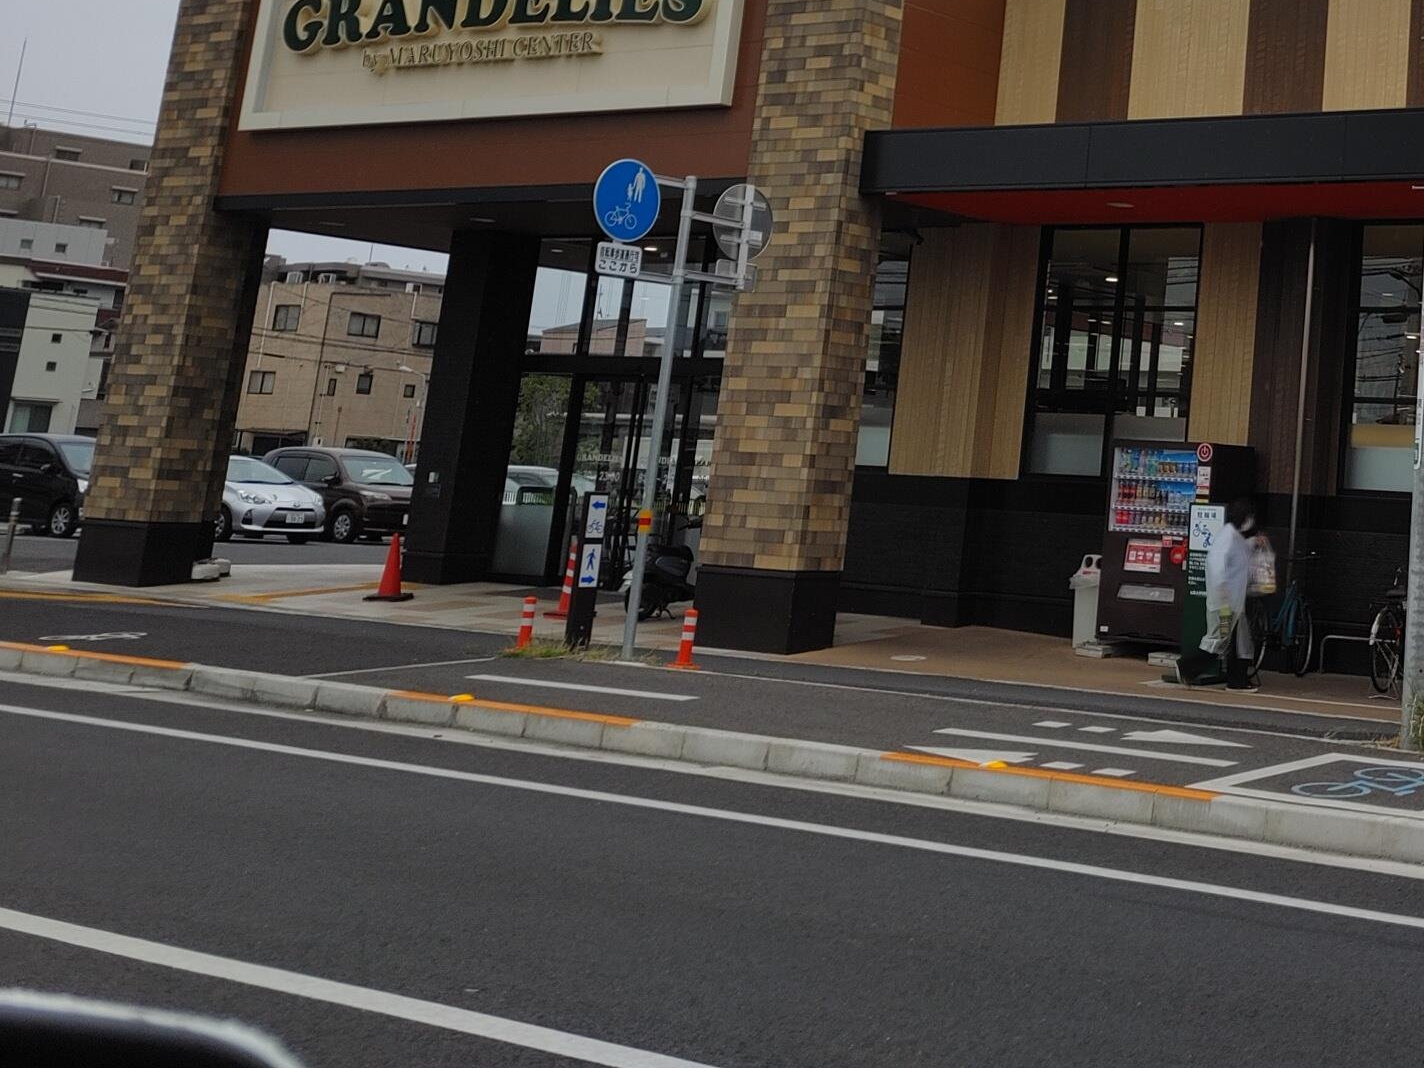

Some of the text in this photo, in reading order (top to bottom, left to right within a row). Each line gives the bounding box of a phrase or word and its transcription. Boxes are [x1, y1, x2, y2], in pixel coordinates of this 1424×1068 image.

[361, 31, 595, 75] by MARUYOSHI CENTER
[598, 259, 638, 274] ここから
